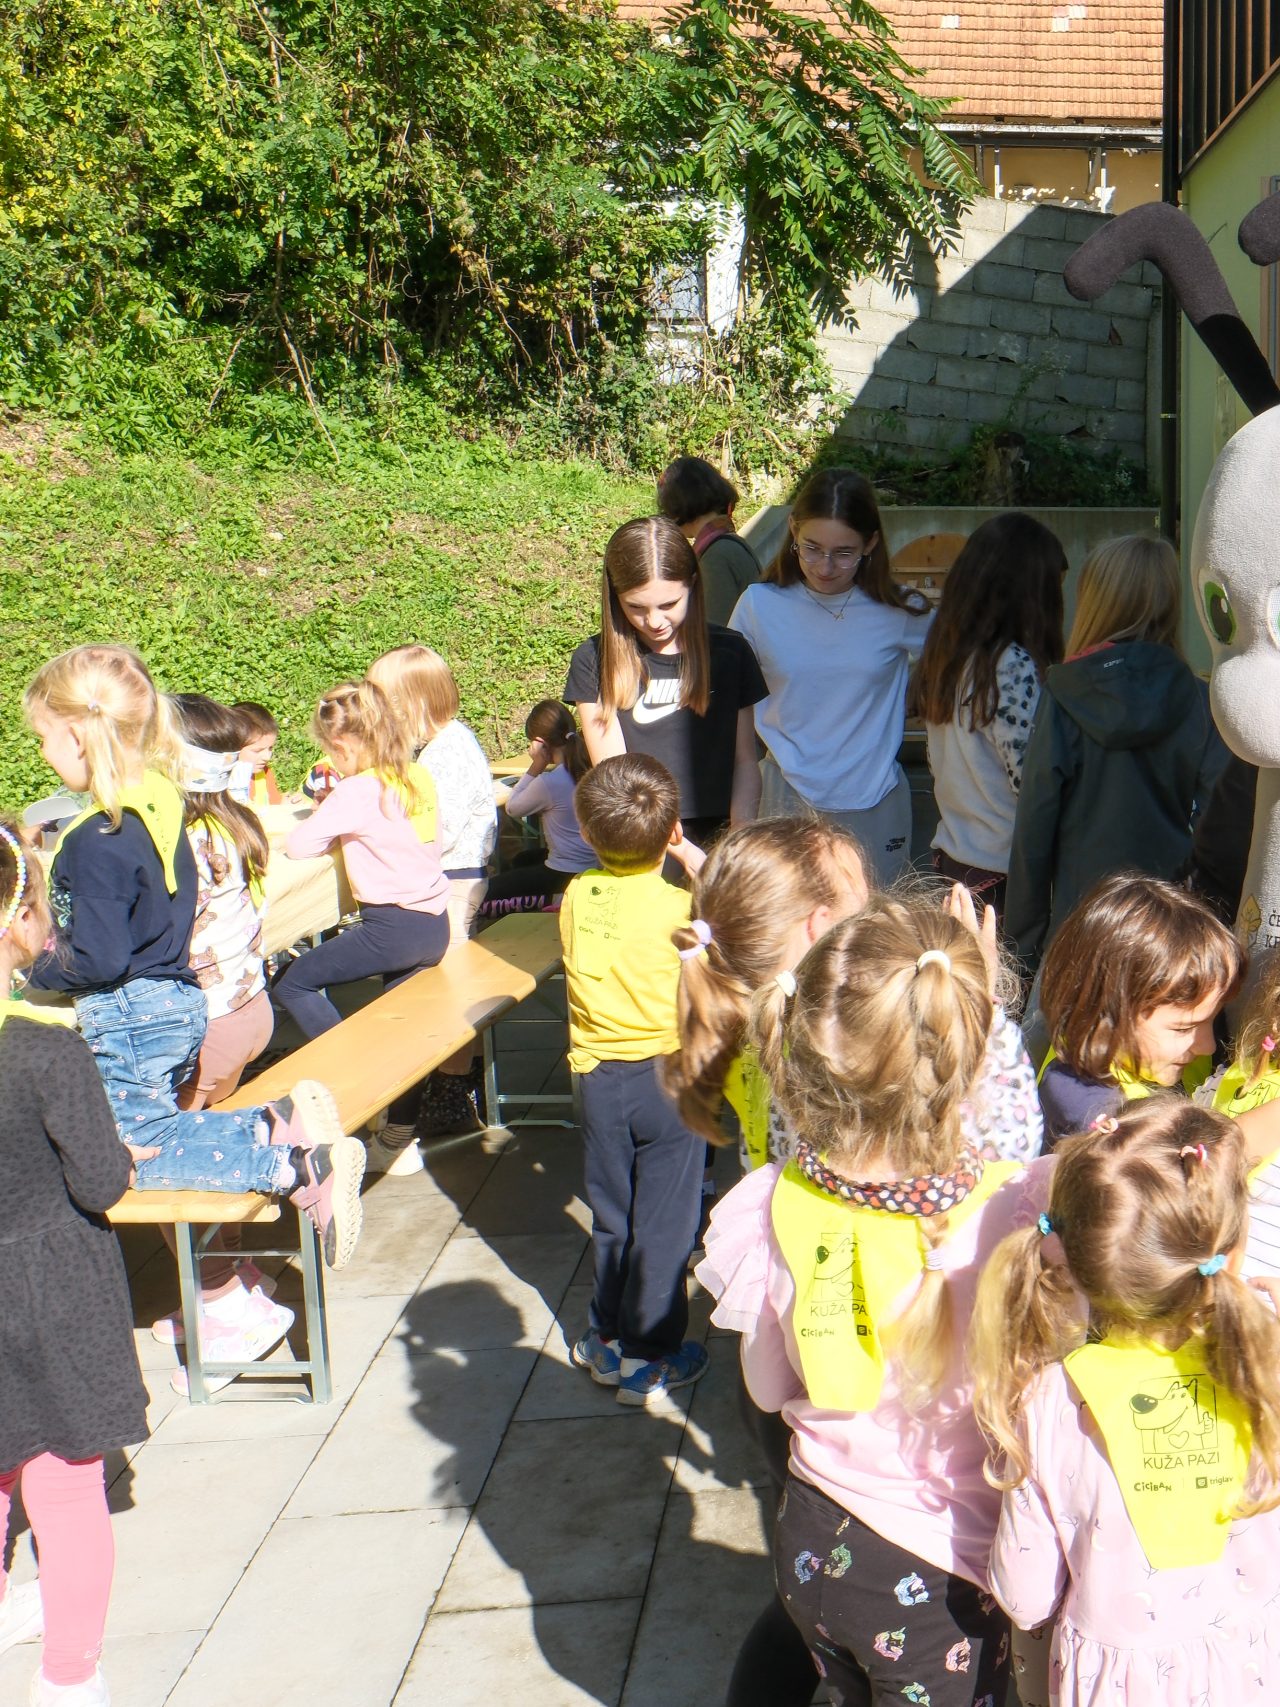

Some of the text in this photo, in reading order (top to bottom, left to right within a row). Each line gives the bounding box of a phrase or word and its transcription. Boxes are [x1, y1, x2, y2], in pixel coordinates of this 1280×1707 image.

[643, 679, 681, 703] NIK
[810, 1302, 869, 1317] KUŽA PA
[1143, 1451, 1220, 1470] KUŽA PAZI
[1209, 1475, 1234, 1486] triglav
